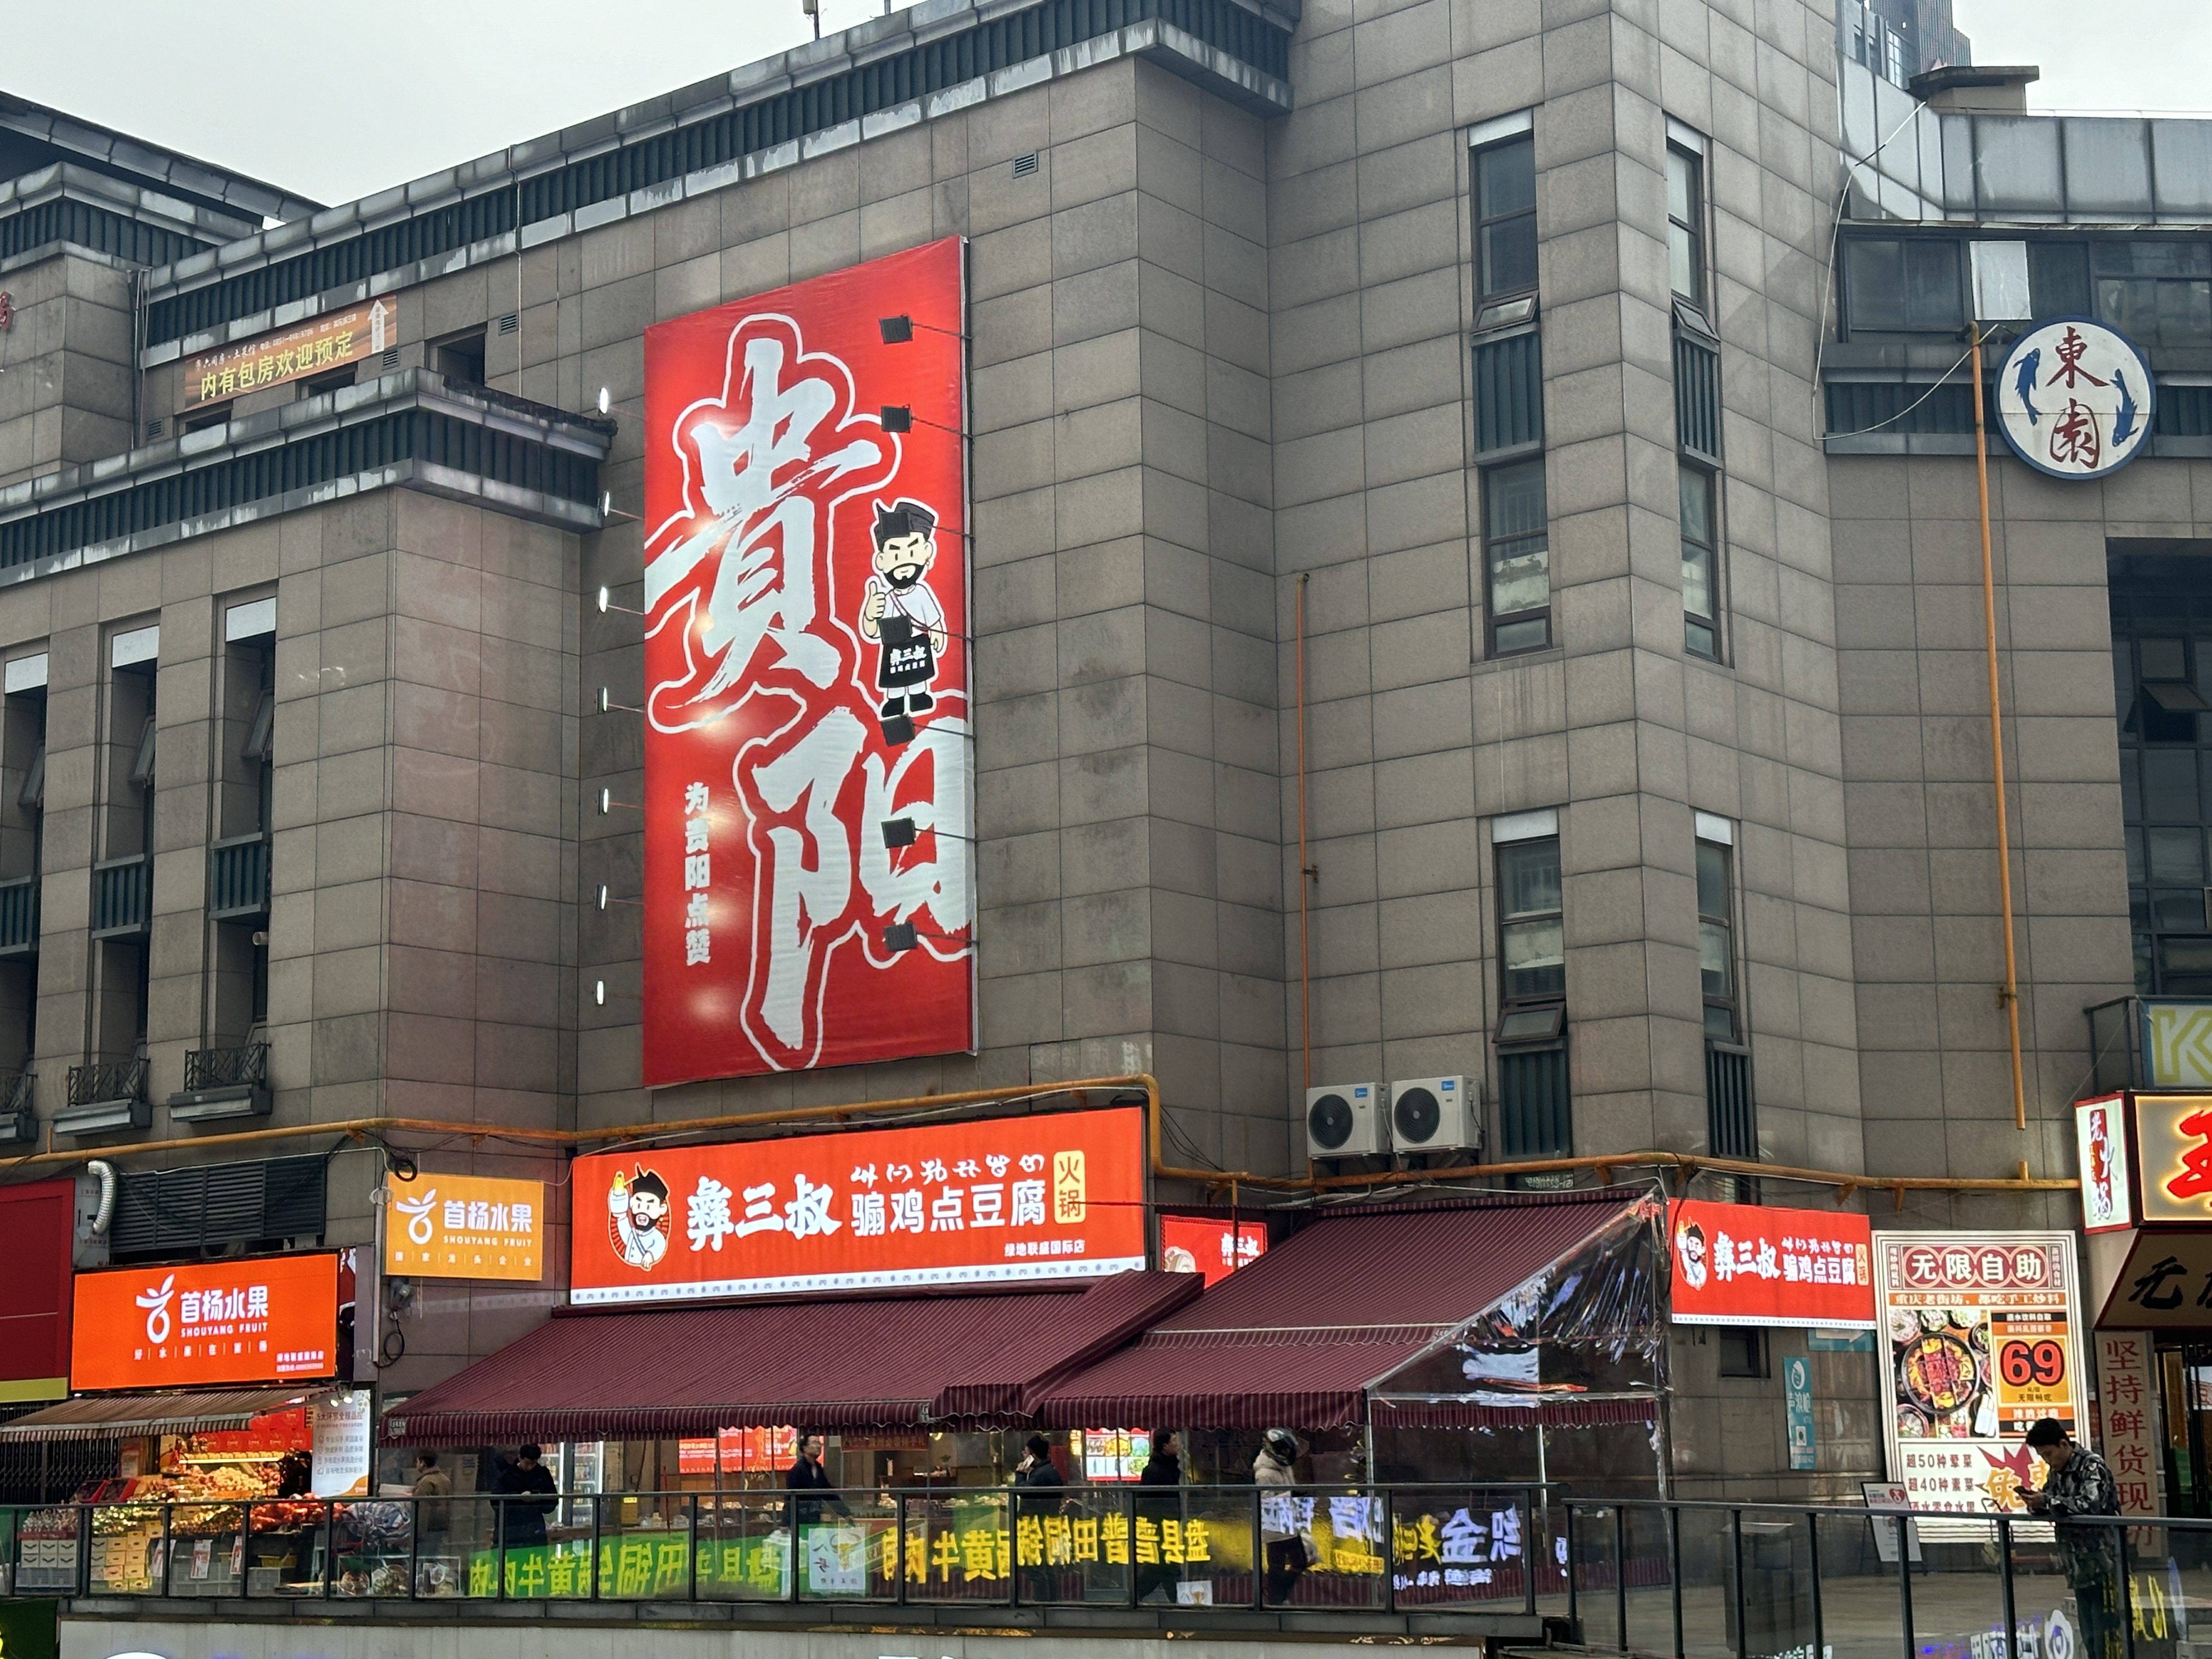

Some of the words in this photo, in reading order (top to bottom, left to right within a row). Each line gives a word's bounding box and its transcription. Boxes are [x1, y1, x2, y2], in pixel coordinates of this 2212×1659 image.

[201, 331, 353, 401] 内有包房欢迎预定
[684, 781, 711, 967] 为贵阳点赞
[1059, 1155, 1081, 1218] 火锅
[444, 1200, 533, 1232] 首杨水果
[686, 1173, 843, 1251] 彝三叔
[851, 1179, 1046, 1237] 骟鸡点豆腐
[443, 1235, 498, 1246] SHOUYANG
[504, 1238, 532, 1247] FRUIT
[1004, 1239, 1085, 1257] 绿地联盛国际店
[1713, 1231, 1781, 1282] 彝三叔
[1782, 1253, 1856, 1285] 骟鸡点豆腐
[1911, 1254, 2042, 1281] 无限自助
[180, 1285, 268, 1323] 首杨水果
[180, 1323, 234, 1339] SHOUYANG
[239, 1322, 268, 1333] FRUIT
[2000, 1339, 2065, 1386] 69
[2017, 1393, 2053, 1403] 无限畅吃
[1906, 1453, 1973, 1469] 超50种荤菜
[1908, 1477, 1976, 1492] 超40种素菜
